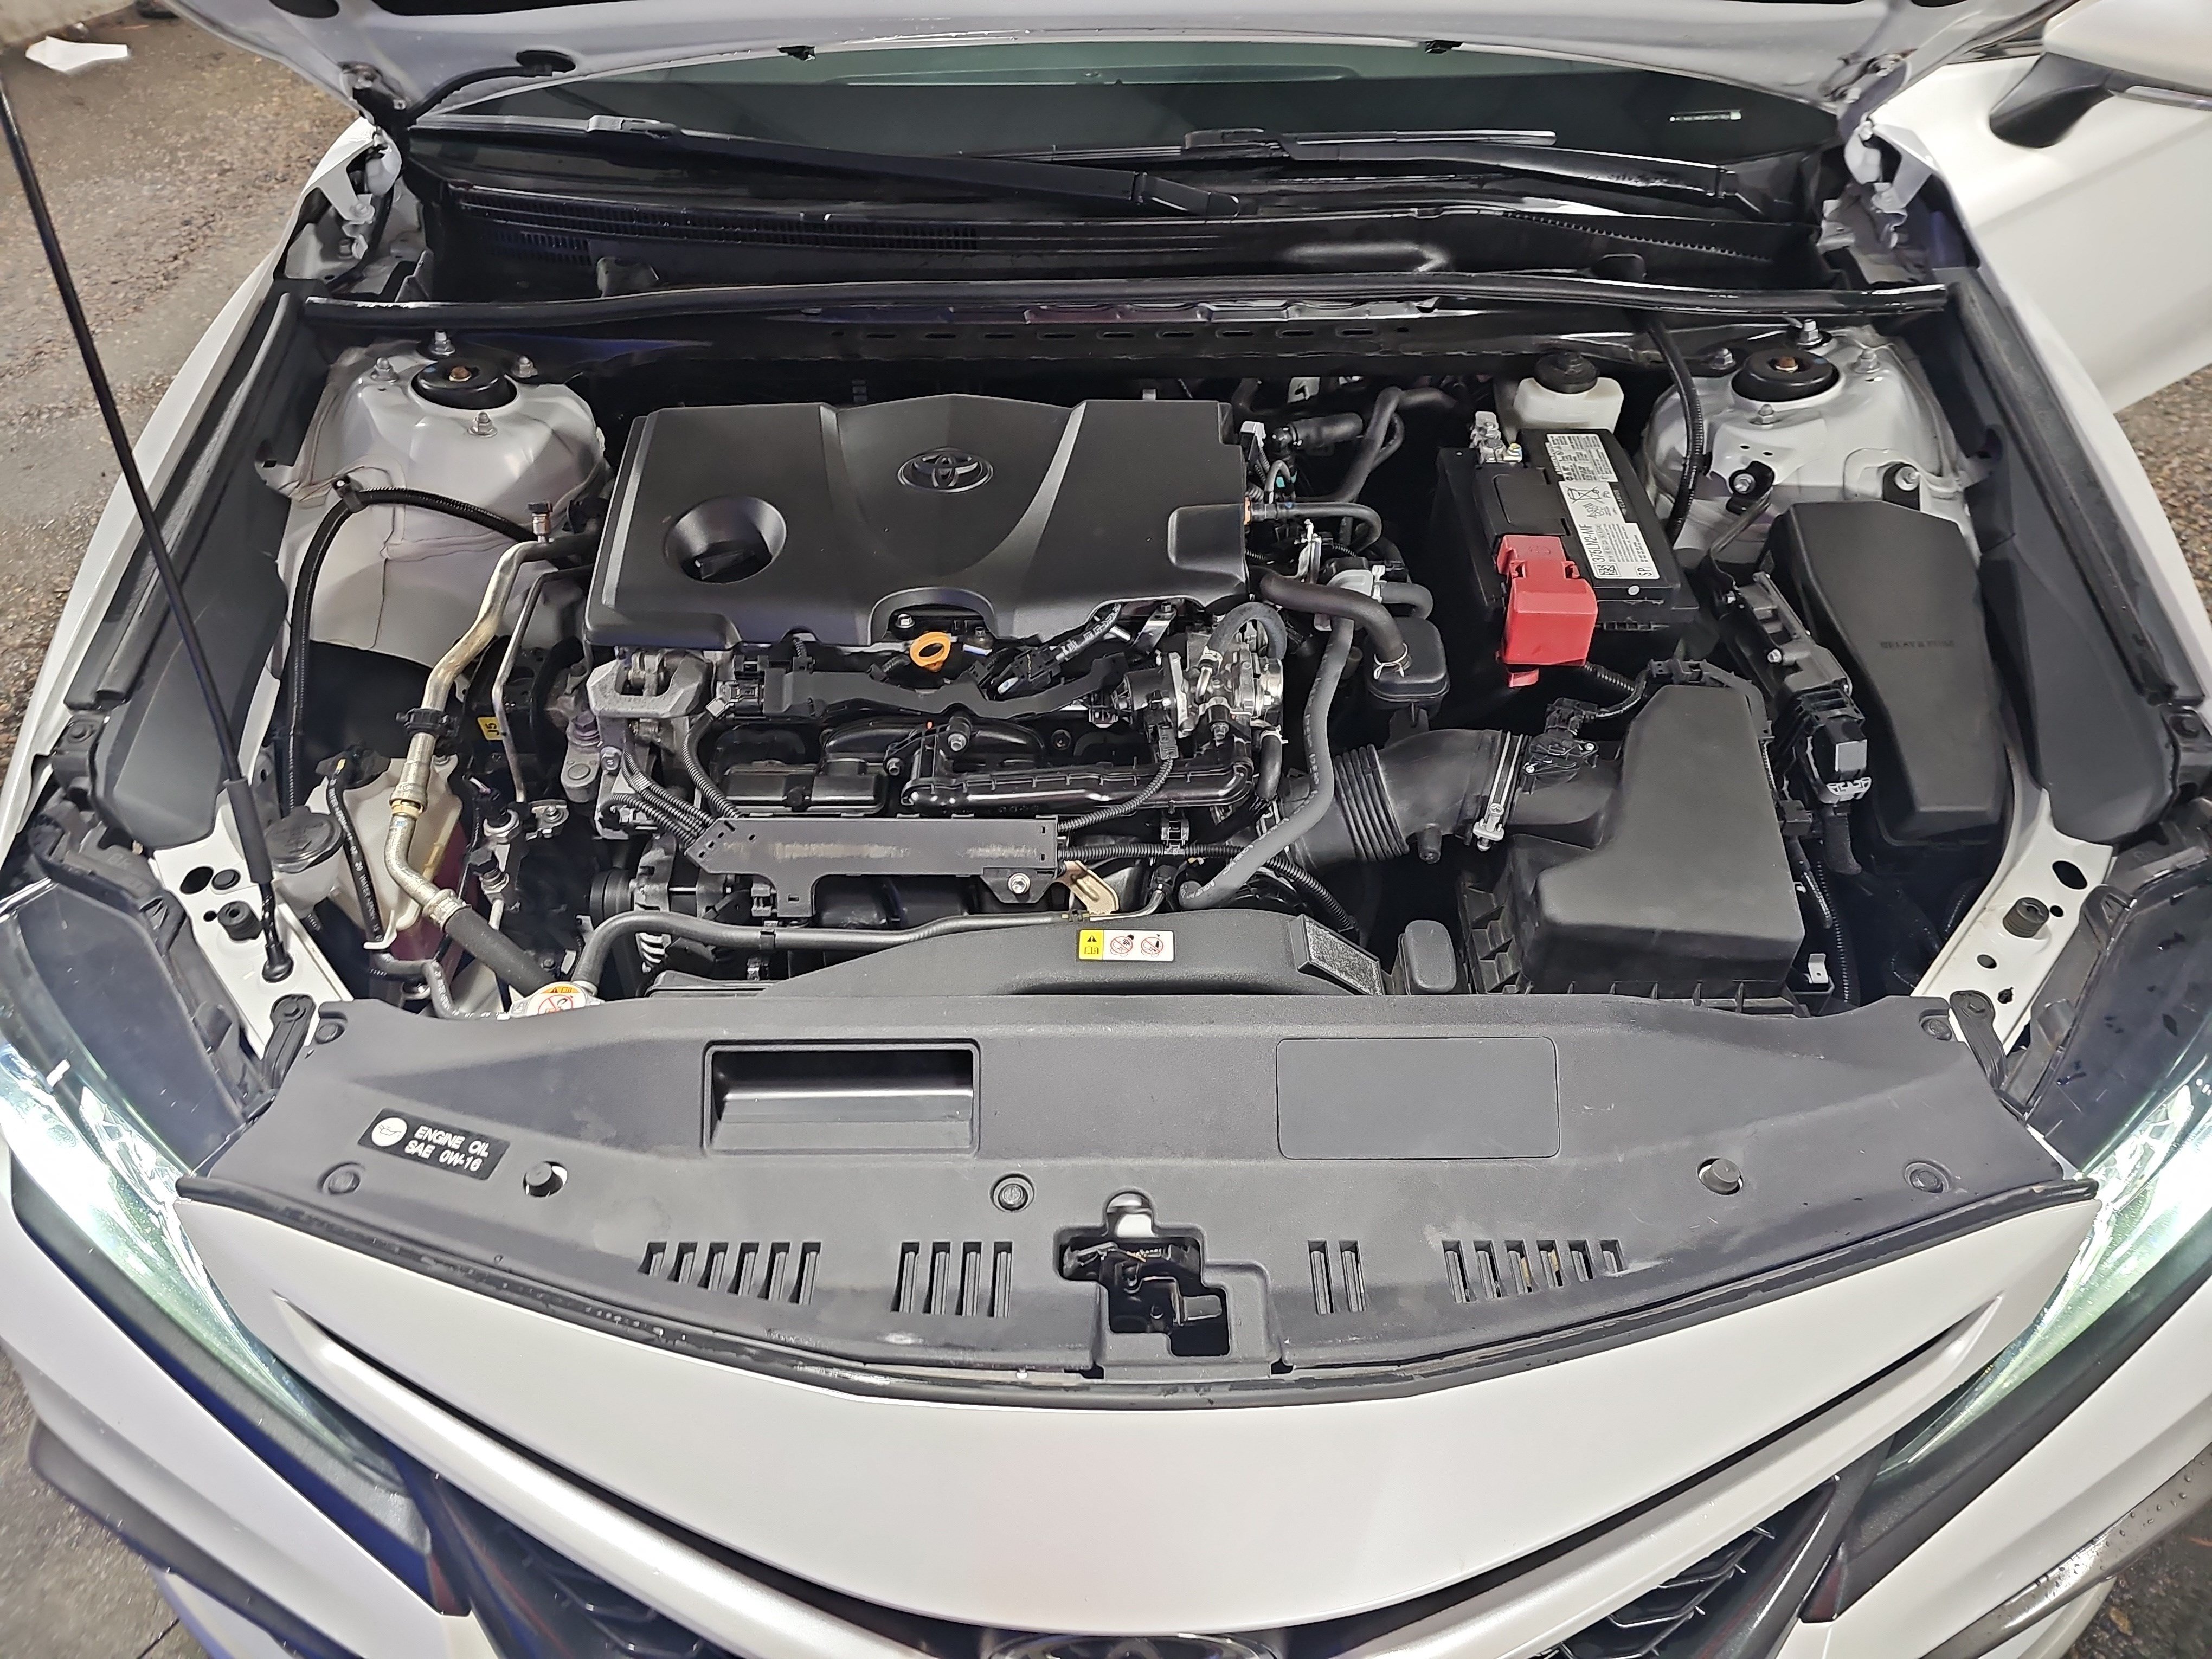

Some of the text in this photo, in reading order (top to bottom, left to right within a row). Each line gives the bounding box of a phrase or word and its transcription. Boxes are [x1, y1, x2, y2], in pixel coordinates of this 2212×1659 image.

[1578, 524, 1606, 562] 375LN2-MF
[1637, 567, 1652, 576] SP
[484, 723, 499, 736] J5
[359, 874, 371, 898] WATER
[414, 1125, 490, 1158] ENGINE OIL
[404, 1140, 483, 1172] SAE 0W-16
